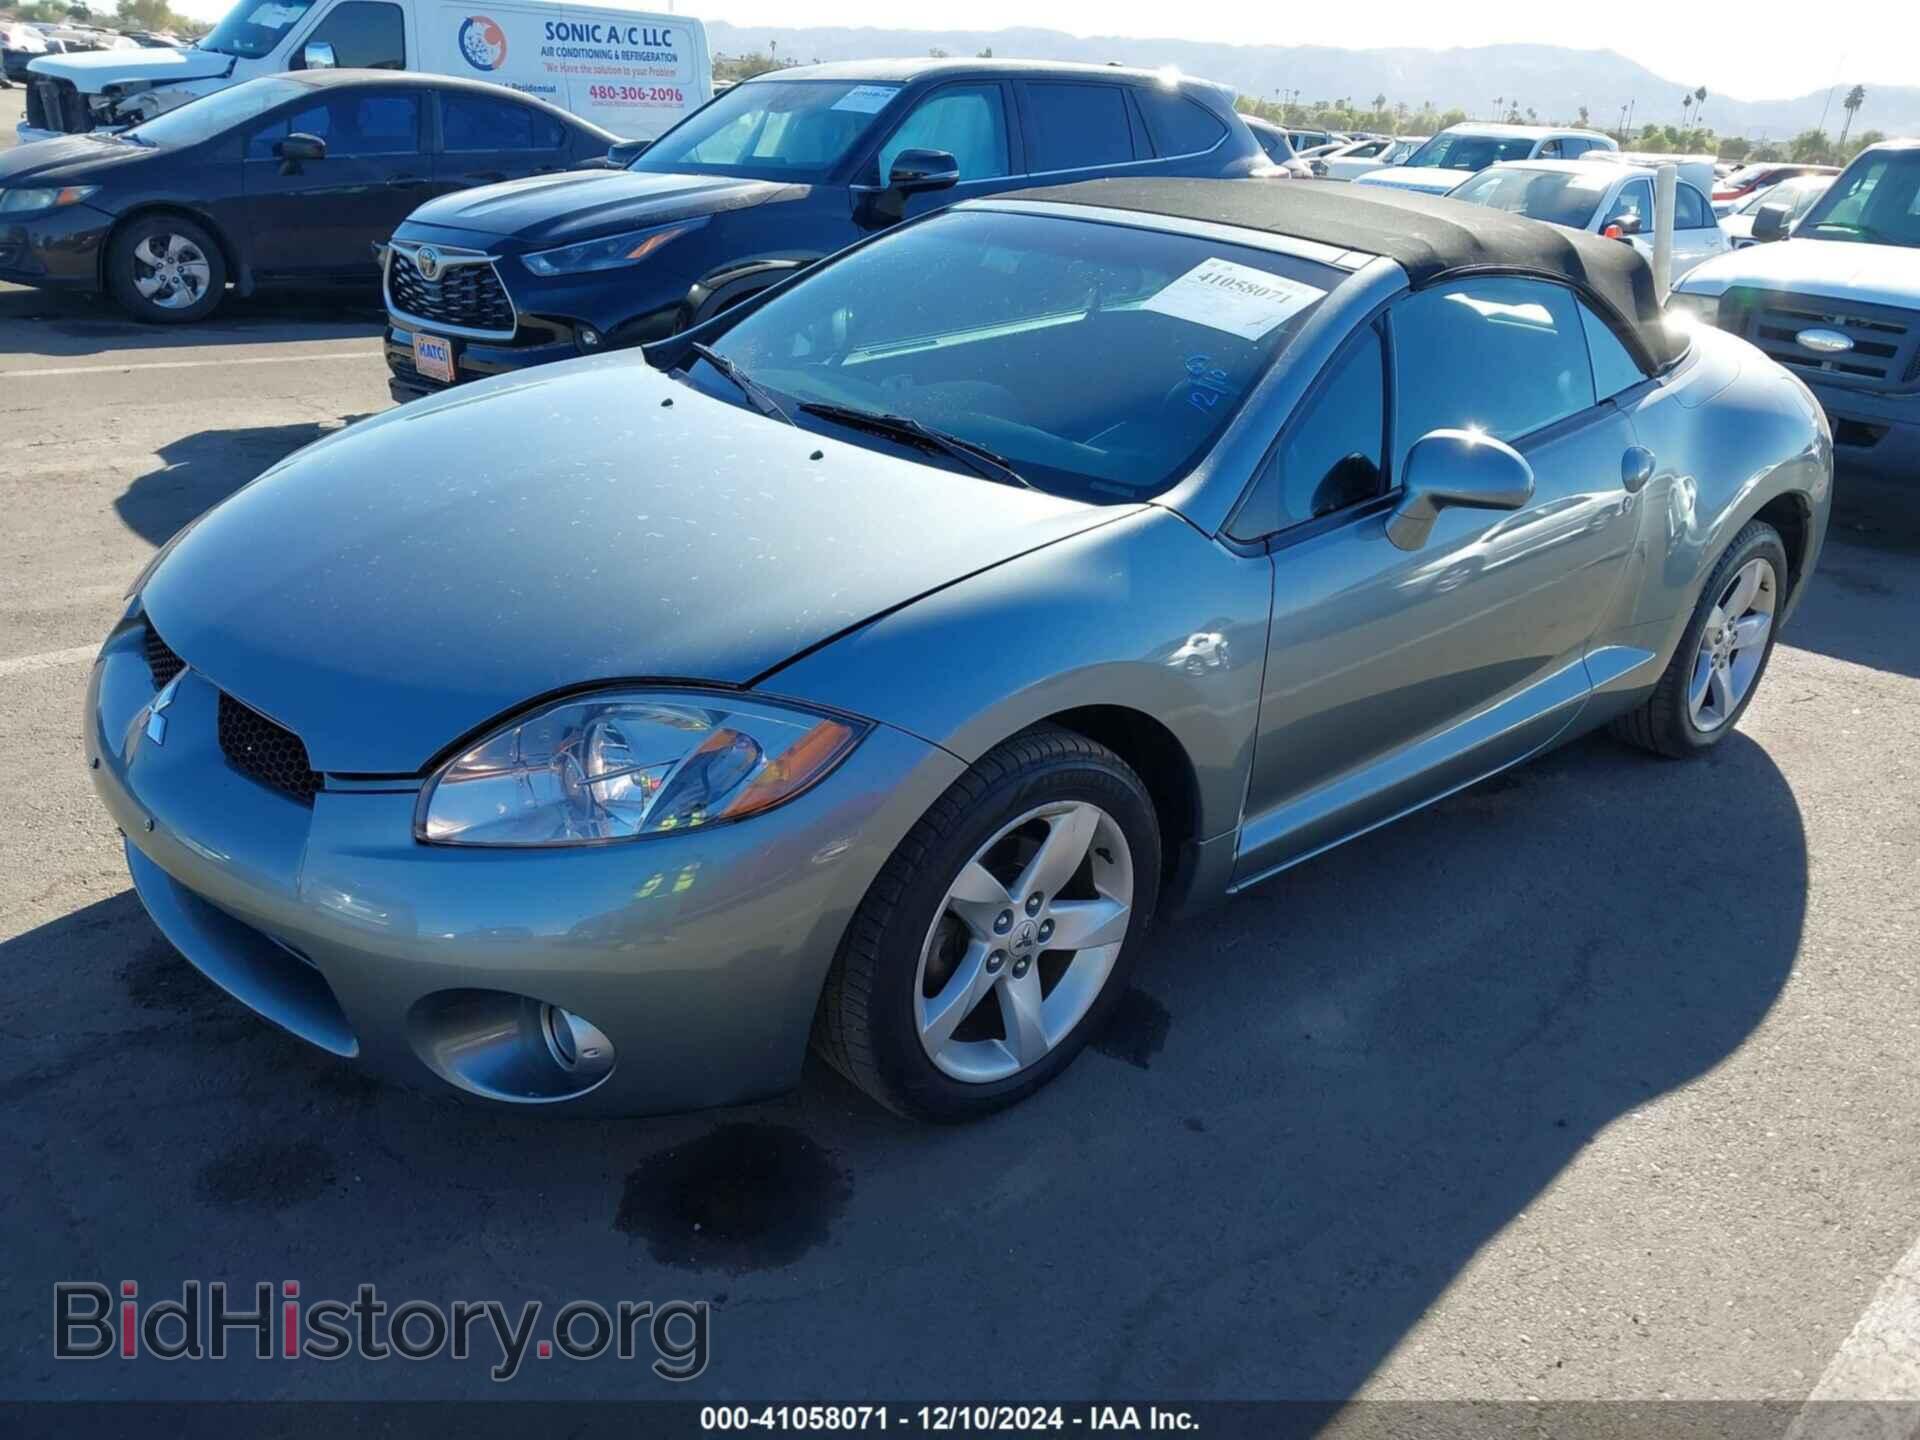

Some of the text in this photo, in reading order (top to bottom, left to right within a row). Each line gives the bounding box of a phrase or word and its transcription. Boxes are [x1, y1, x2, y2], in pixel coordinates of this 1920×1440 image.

[545, 21, 672, 47] SONIC A/C LLC
[541, 46, 554, 56] AIR
[556, 47, 613, 60] CONDITIONING
[621, 50, 678, 62] REFRIGERATION
[590, 85, 683, 101] 480-306-2096
[1199, 272, 1292, 304] 41058071
